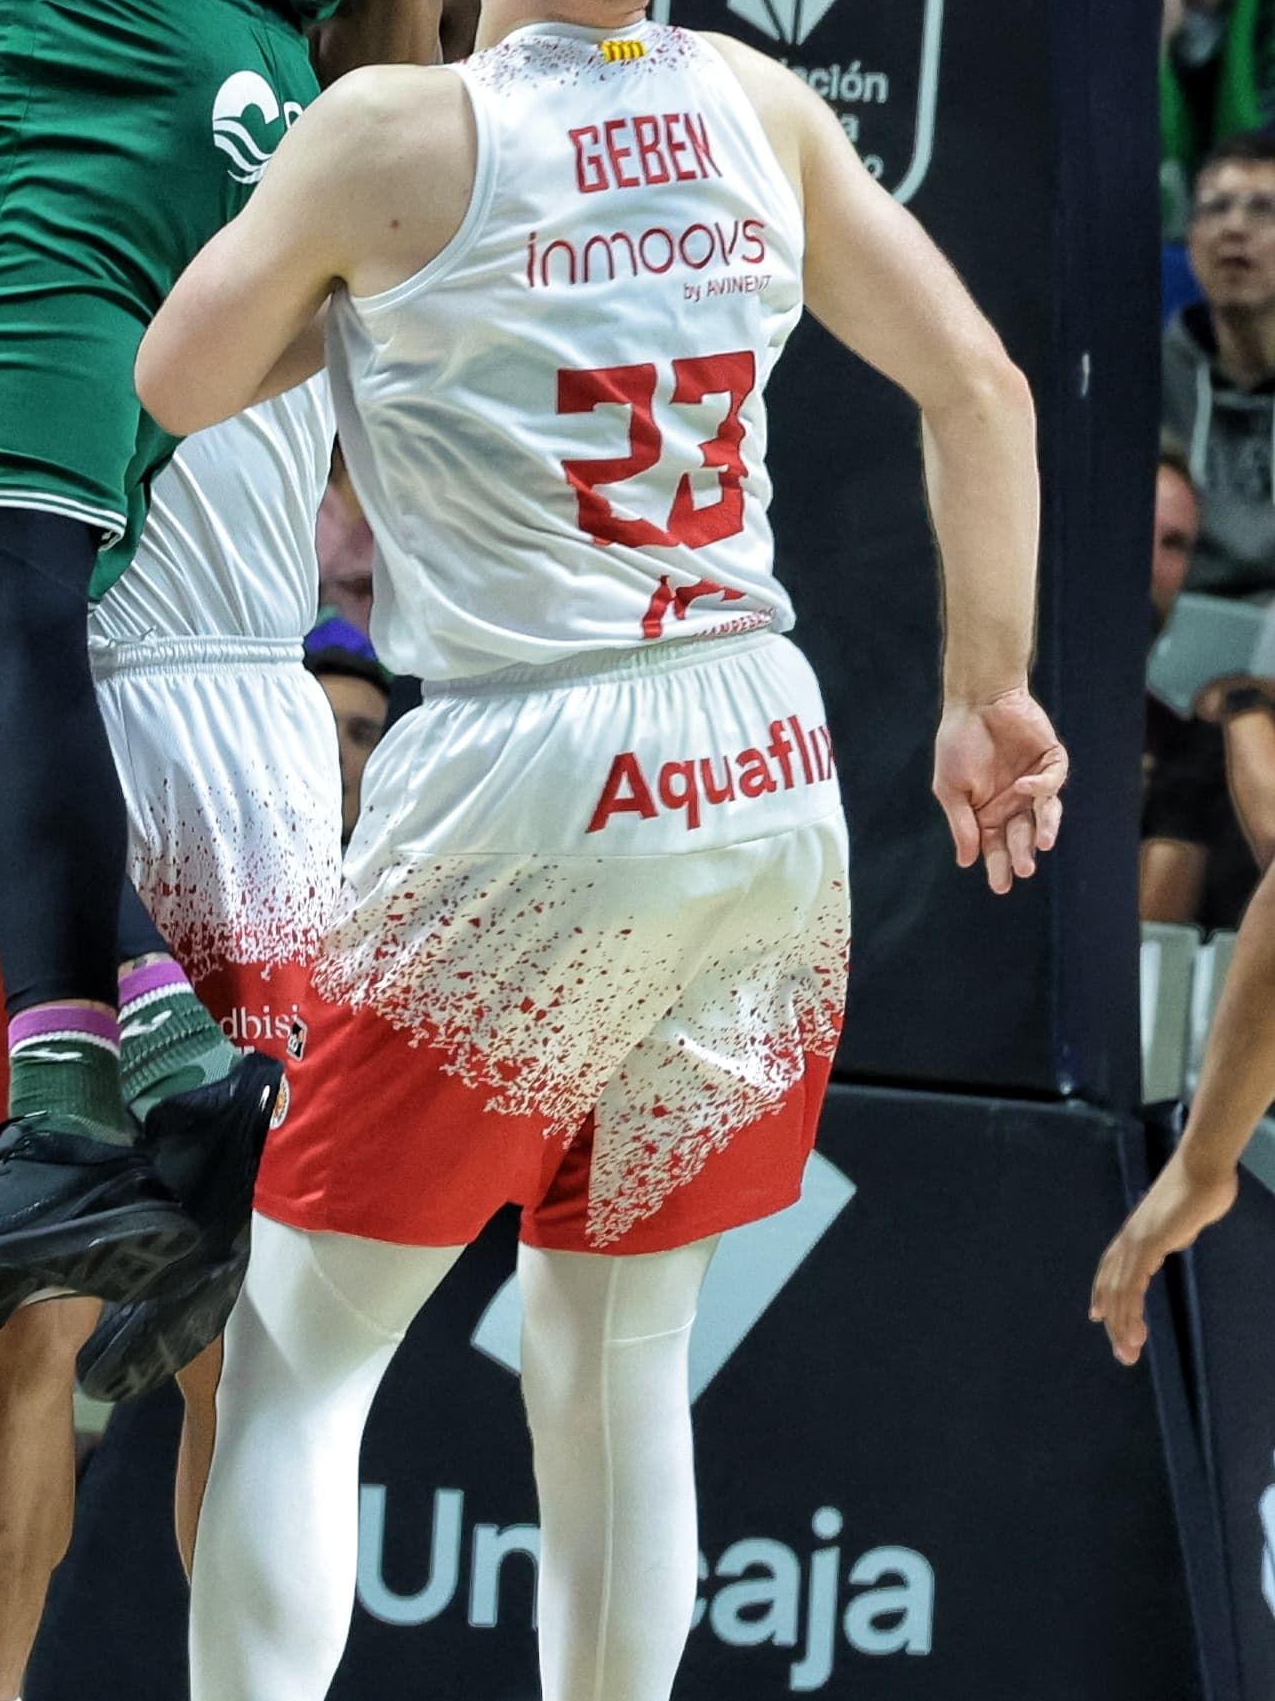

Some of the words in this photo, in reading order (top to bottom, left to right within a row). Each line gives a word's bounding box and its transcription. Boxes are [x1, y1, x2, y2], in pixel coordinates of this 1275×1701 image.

[568, 112, 723, 194] GEBEN
[555, 349, 756, 551] 23
[356, 1482, 935, 1692] Unaja
